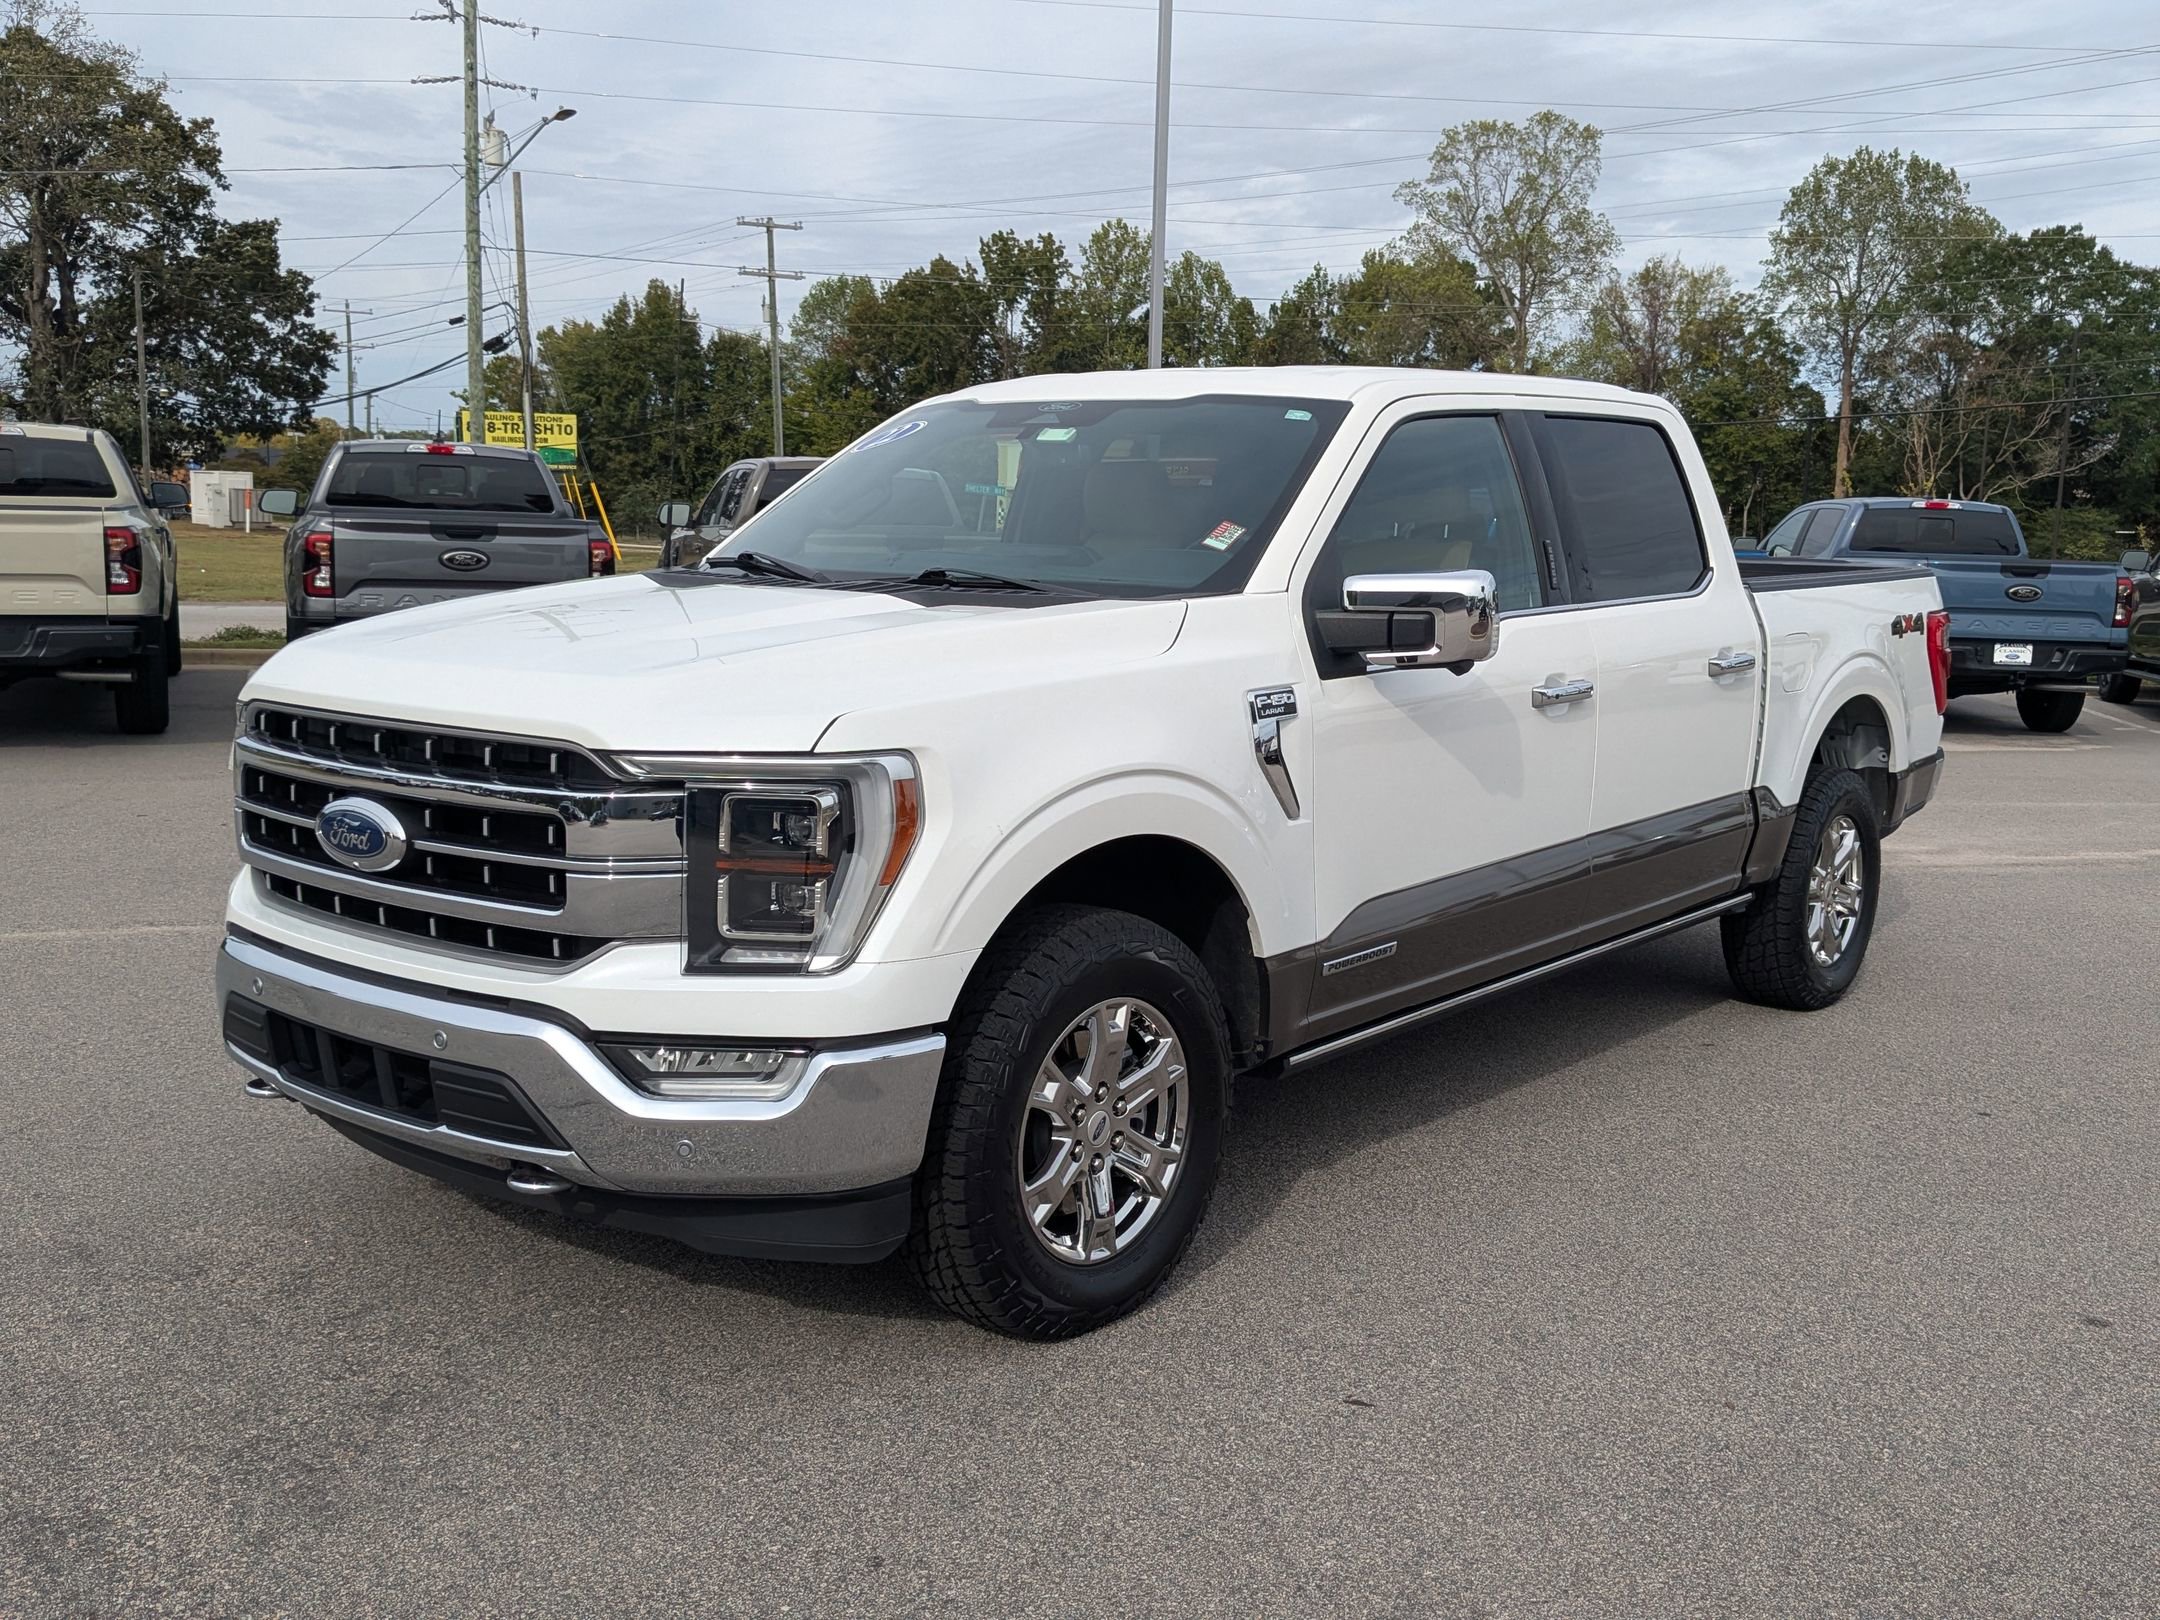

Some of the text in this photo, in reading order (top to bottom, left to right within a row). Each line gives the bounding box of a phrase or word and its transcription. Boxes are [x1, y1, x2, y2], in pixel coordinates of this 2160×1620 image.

[483, 414, 564, 423] AULING SUTIONS
[1256, 693, 1295, 708] F-150
[1261, 706, 1285, 716] LARIAT
[330, 816, 370, 850] Ford
[1327, 945, 1394, 972] POWERBOOST
